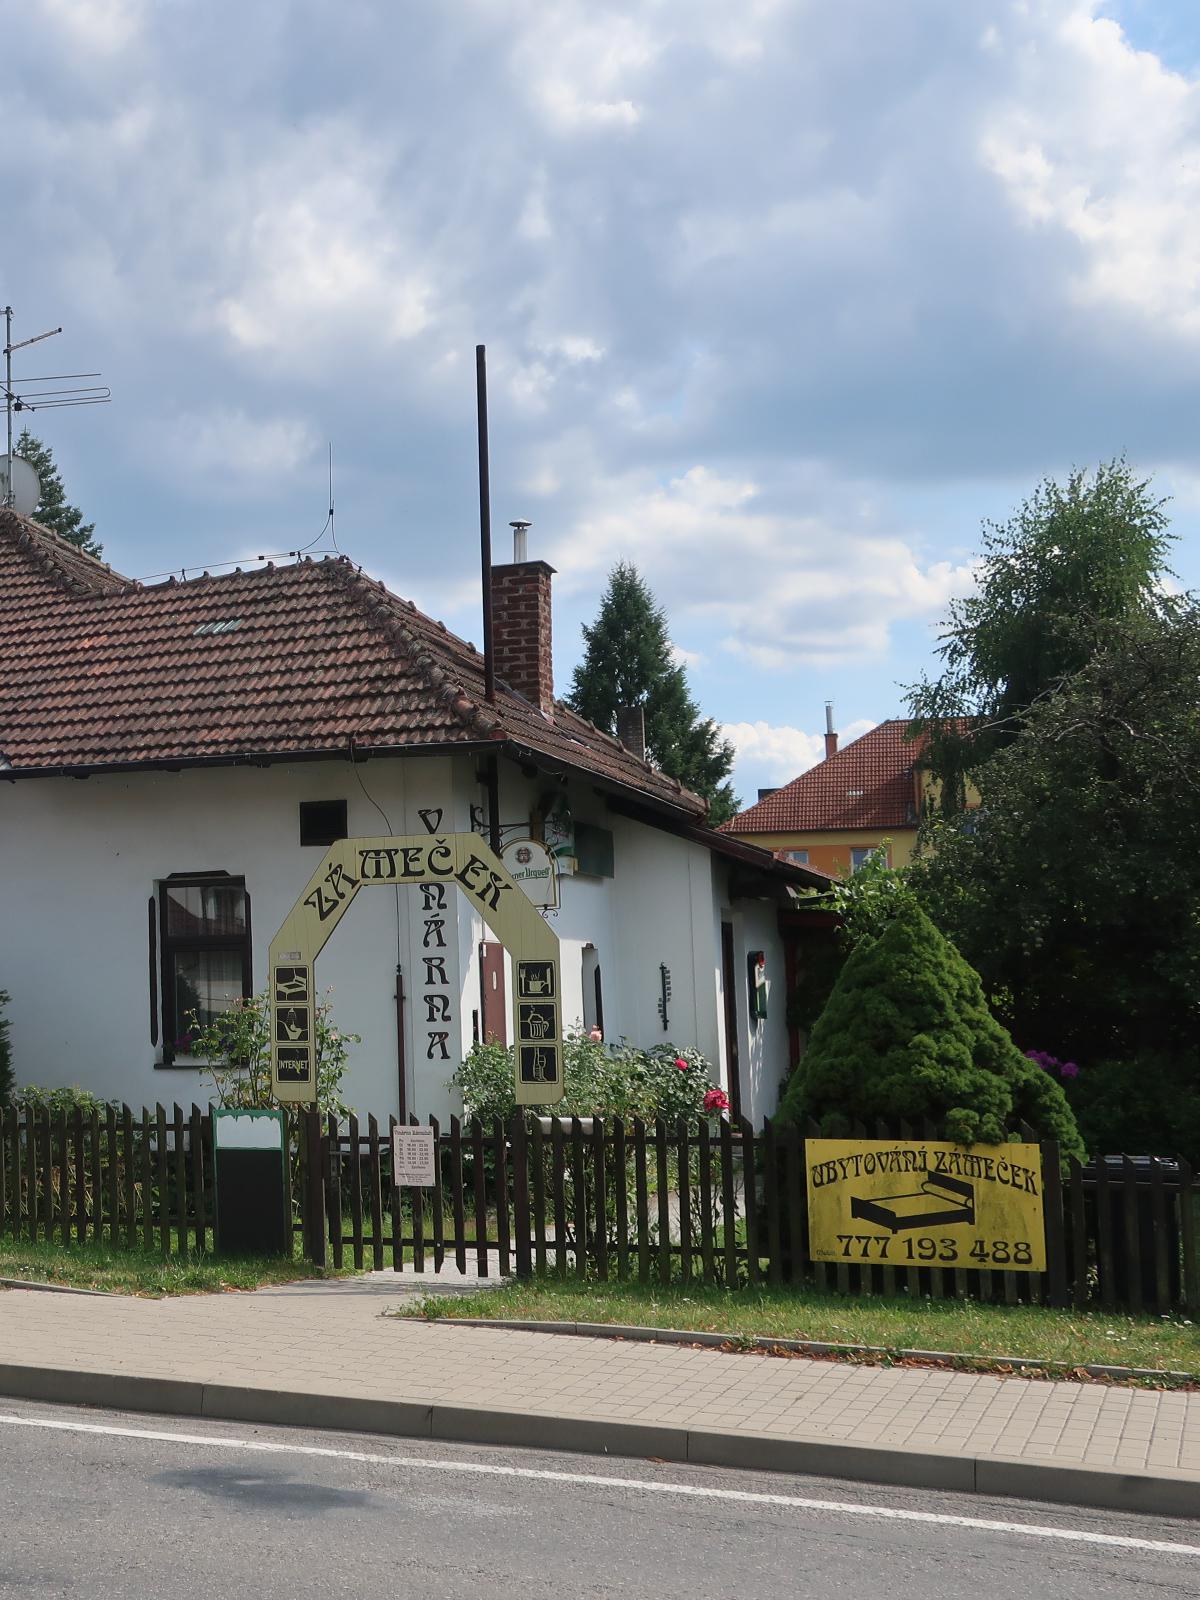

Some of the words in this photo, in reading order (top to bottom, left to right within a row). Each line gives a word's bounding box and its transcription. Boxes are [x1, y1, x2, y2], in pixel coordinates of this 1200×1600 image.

[303, 839, 512, 921] ZÁMEČEK
[278, 1060, 308, 1070] INTERNET
[811, 1146, 928, 1188] UBYTOVÁNÍ
[933, 1149, 1039, 1196] ZÁMEČEK
[837, 1235, 890, 1259] 777
[902, 1238, 959, 1261] 193
[969, 1240, 1033, 1265] 488
